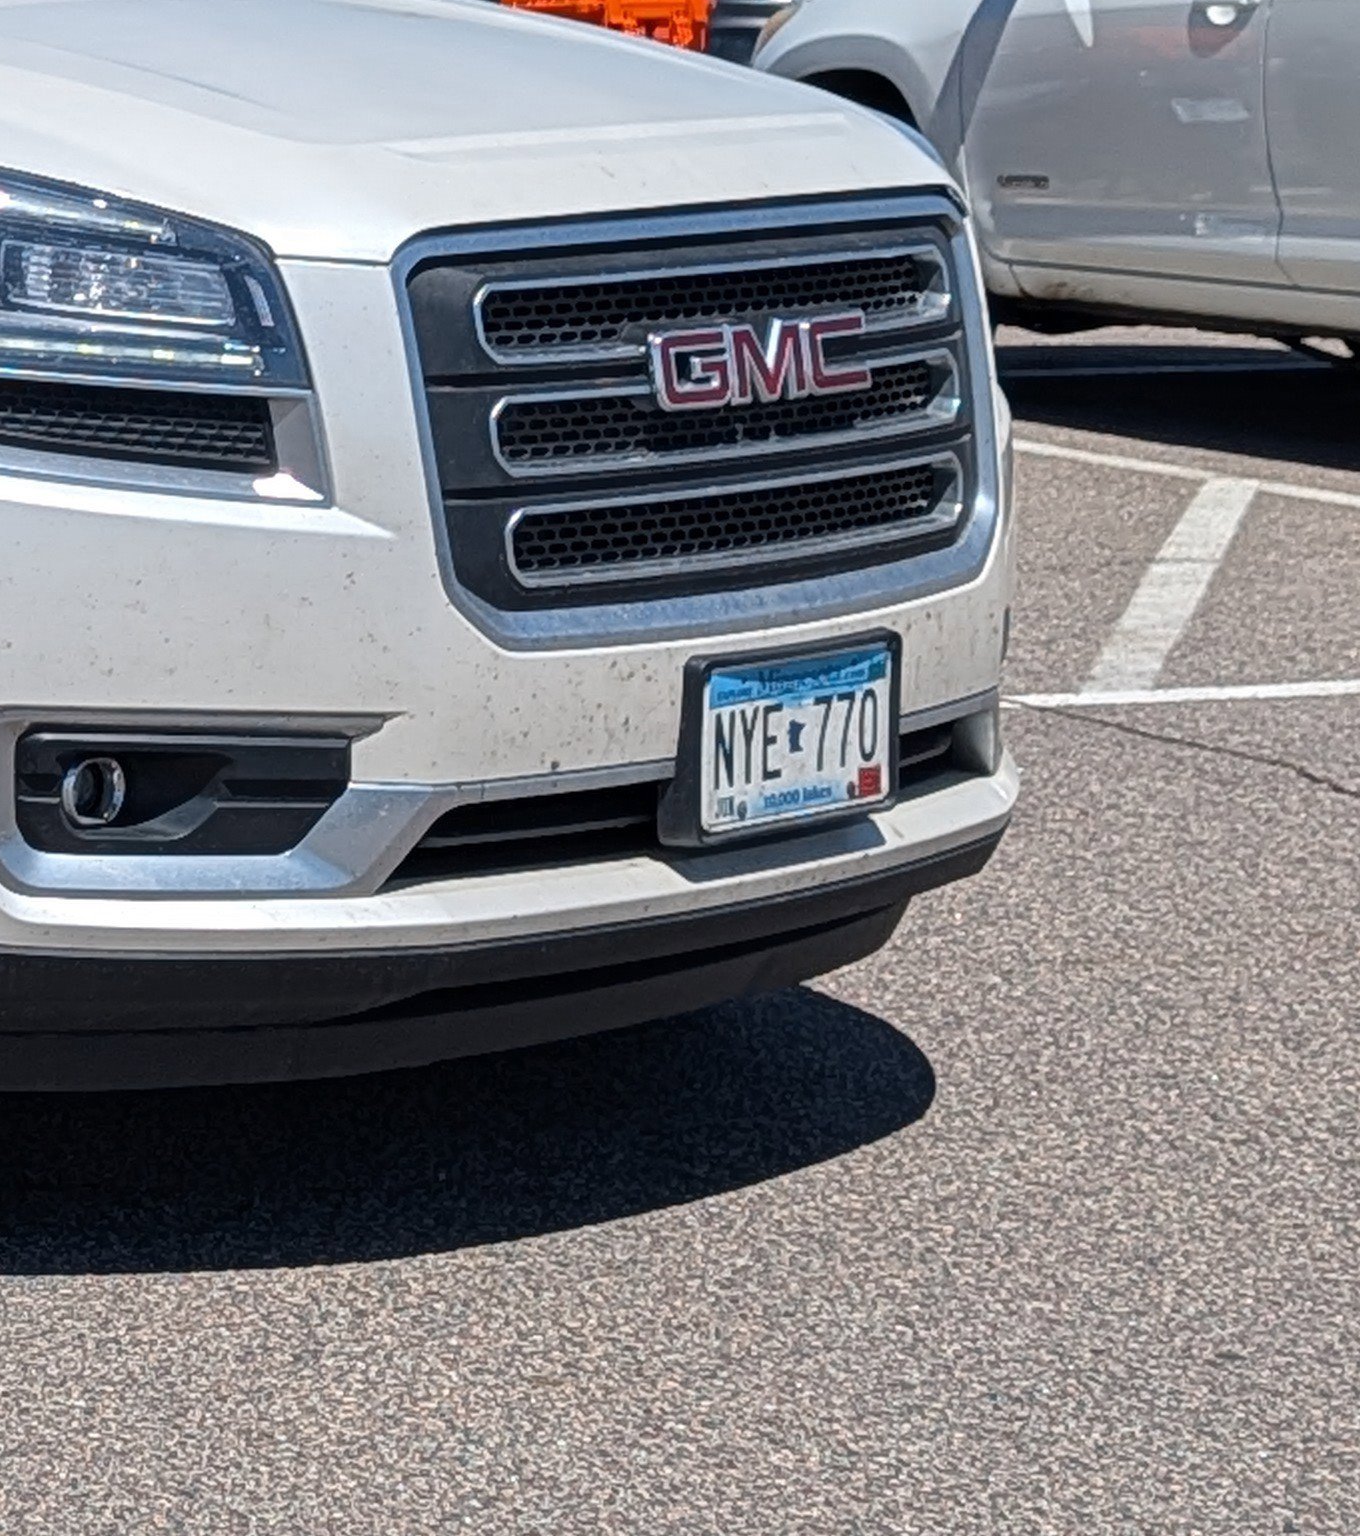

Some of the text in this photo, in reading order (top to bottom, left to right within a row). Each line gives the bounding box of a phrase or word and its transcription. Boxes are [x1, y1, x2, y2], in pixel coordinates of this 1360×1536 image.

[647, 312, 872, 412] GMC
[714, 687, 878, 790] NYE 770
